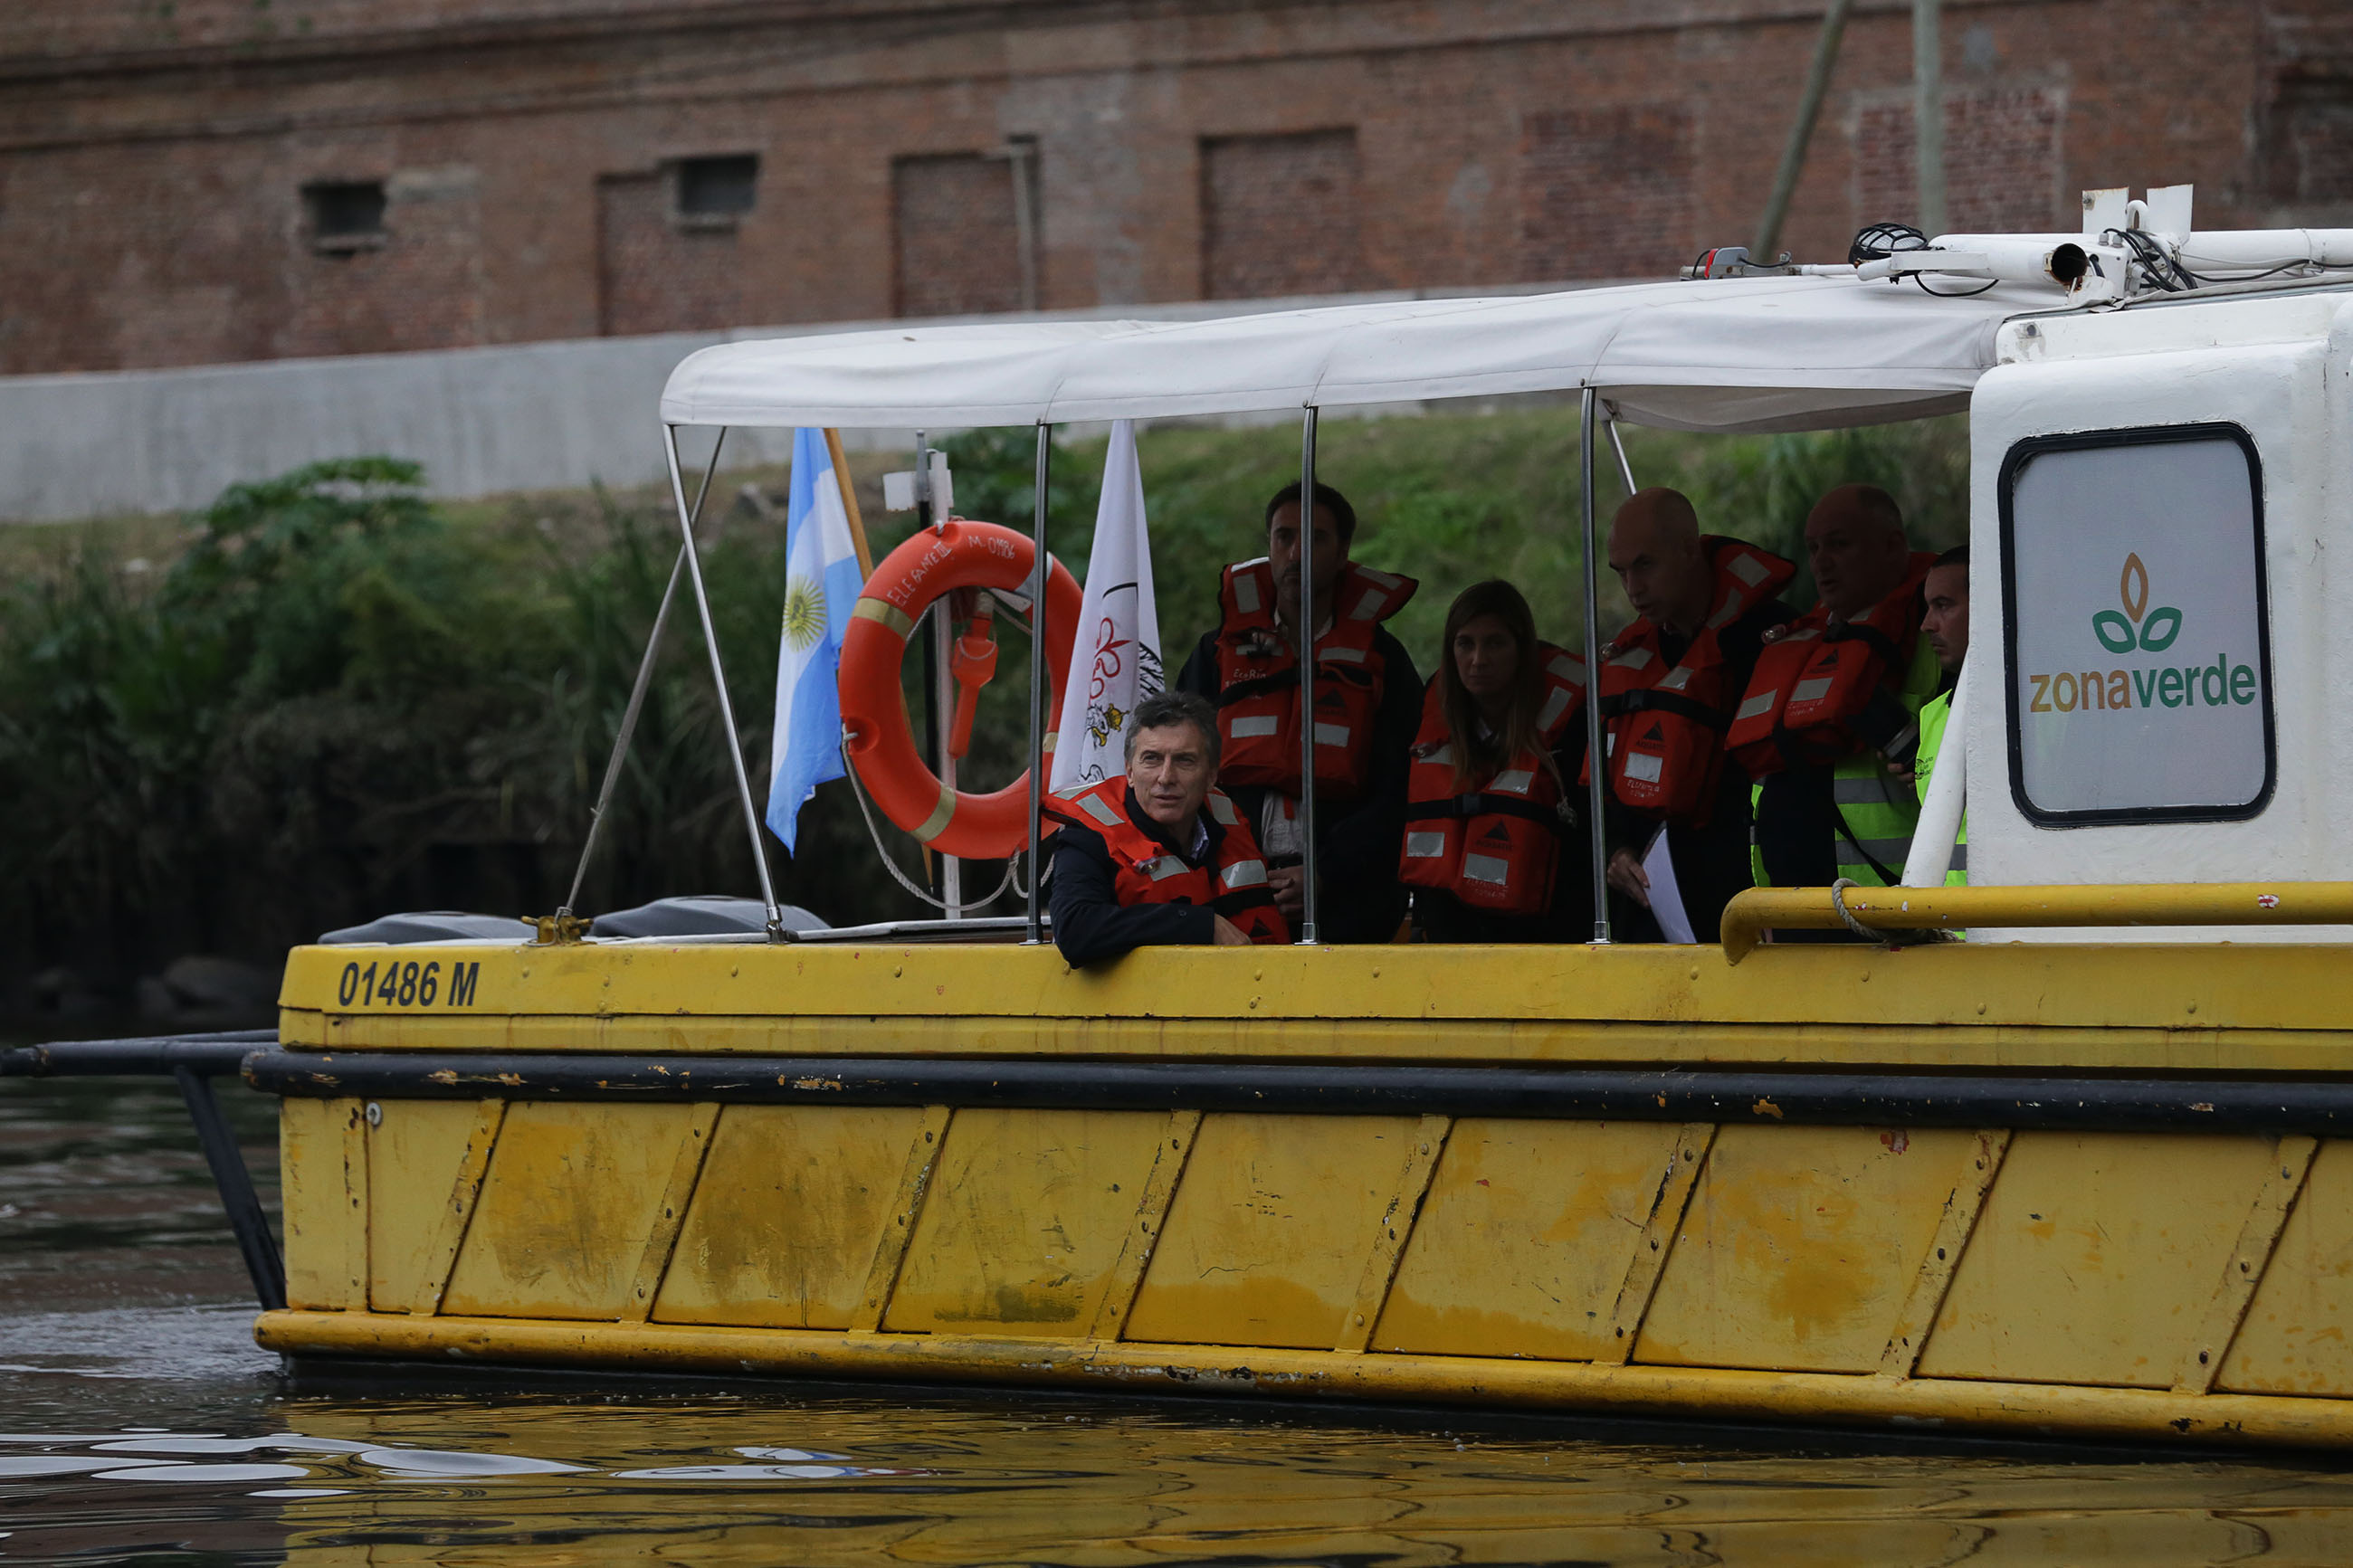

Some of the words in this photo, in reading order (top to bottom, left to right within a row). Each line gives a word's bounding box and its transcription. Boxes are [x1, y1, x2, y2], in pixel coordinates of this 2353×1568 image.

[2029, 652, 2257, 713] zonaverde
[338, 961, 441, 1006] 01486
[448, 962, 480, 1006] M
